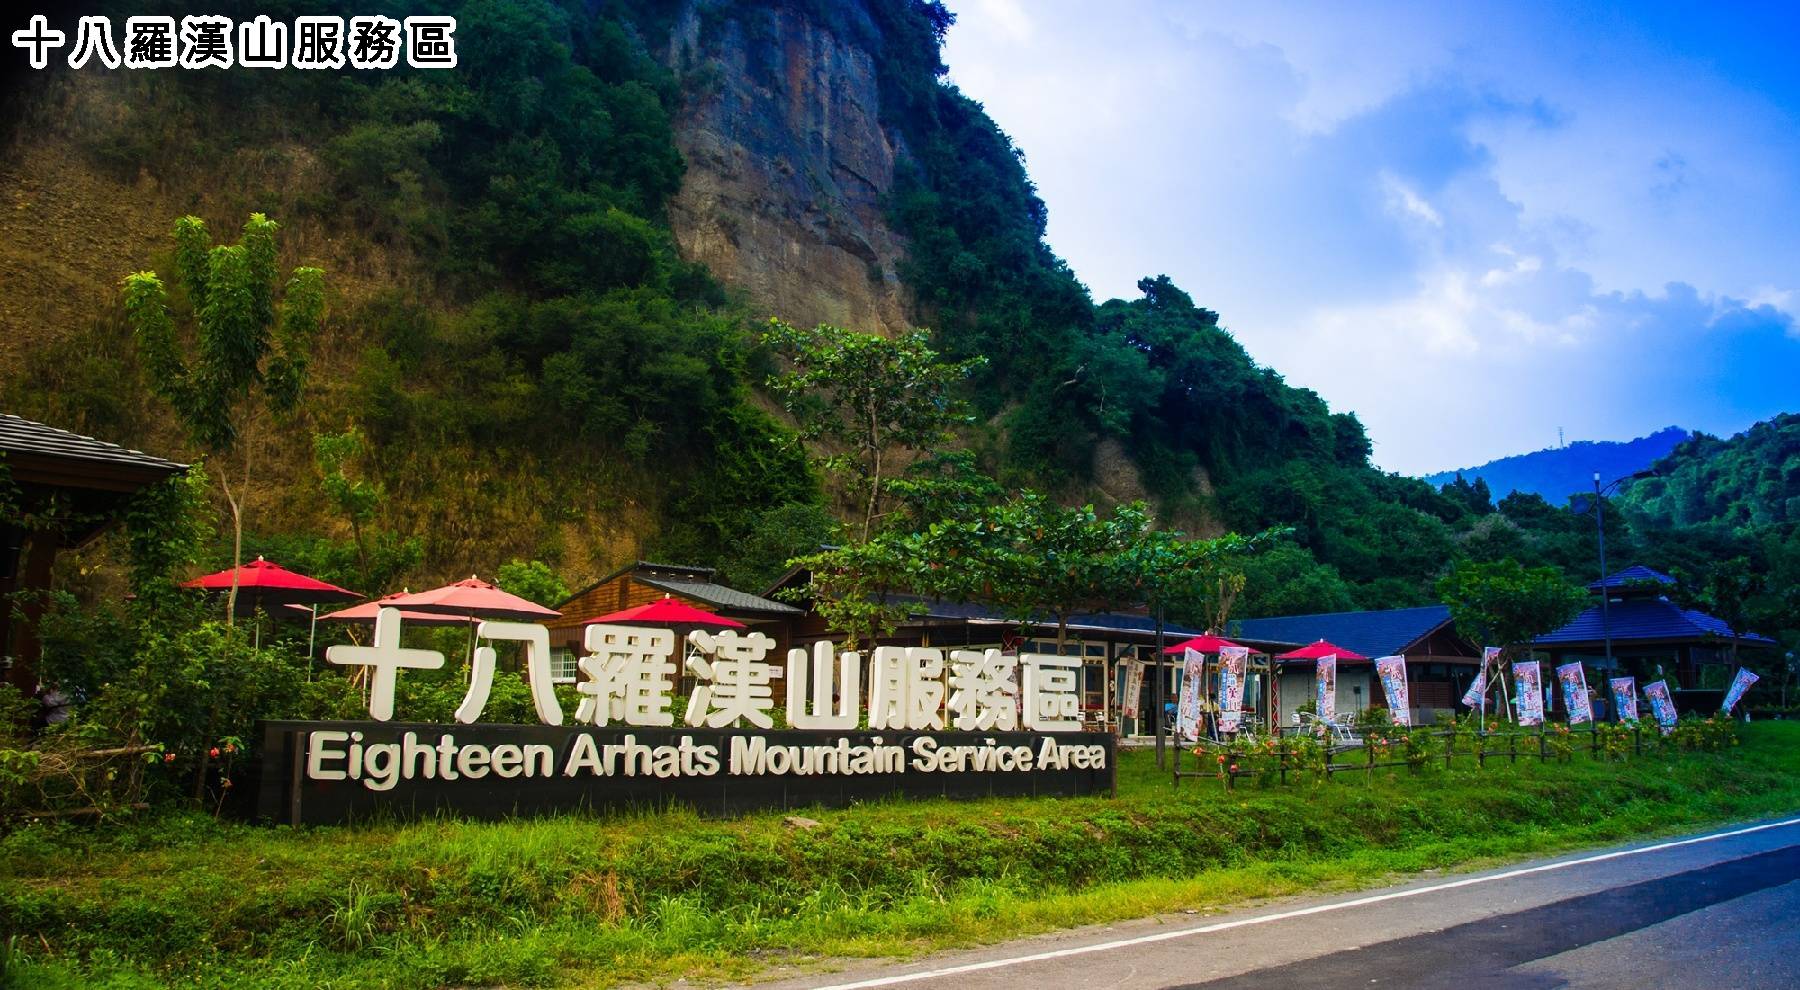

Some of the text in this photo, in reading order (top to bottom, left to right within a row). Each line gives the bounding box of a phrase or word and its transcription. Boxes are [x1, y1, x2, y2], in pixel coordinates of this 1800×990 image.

[326, 607, 1083, 732] 十八羅漢山服務區
[307, 730, 1106, 791] Eighteen Arhats Mountain Service Area
